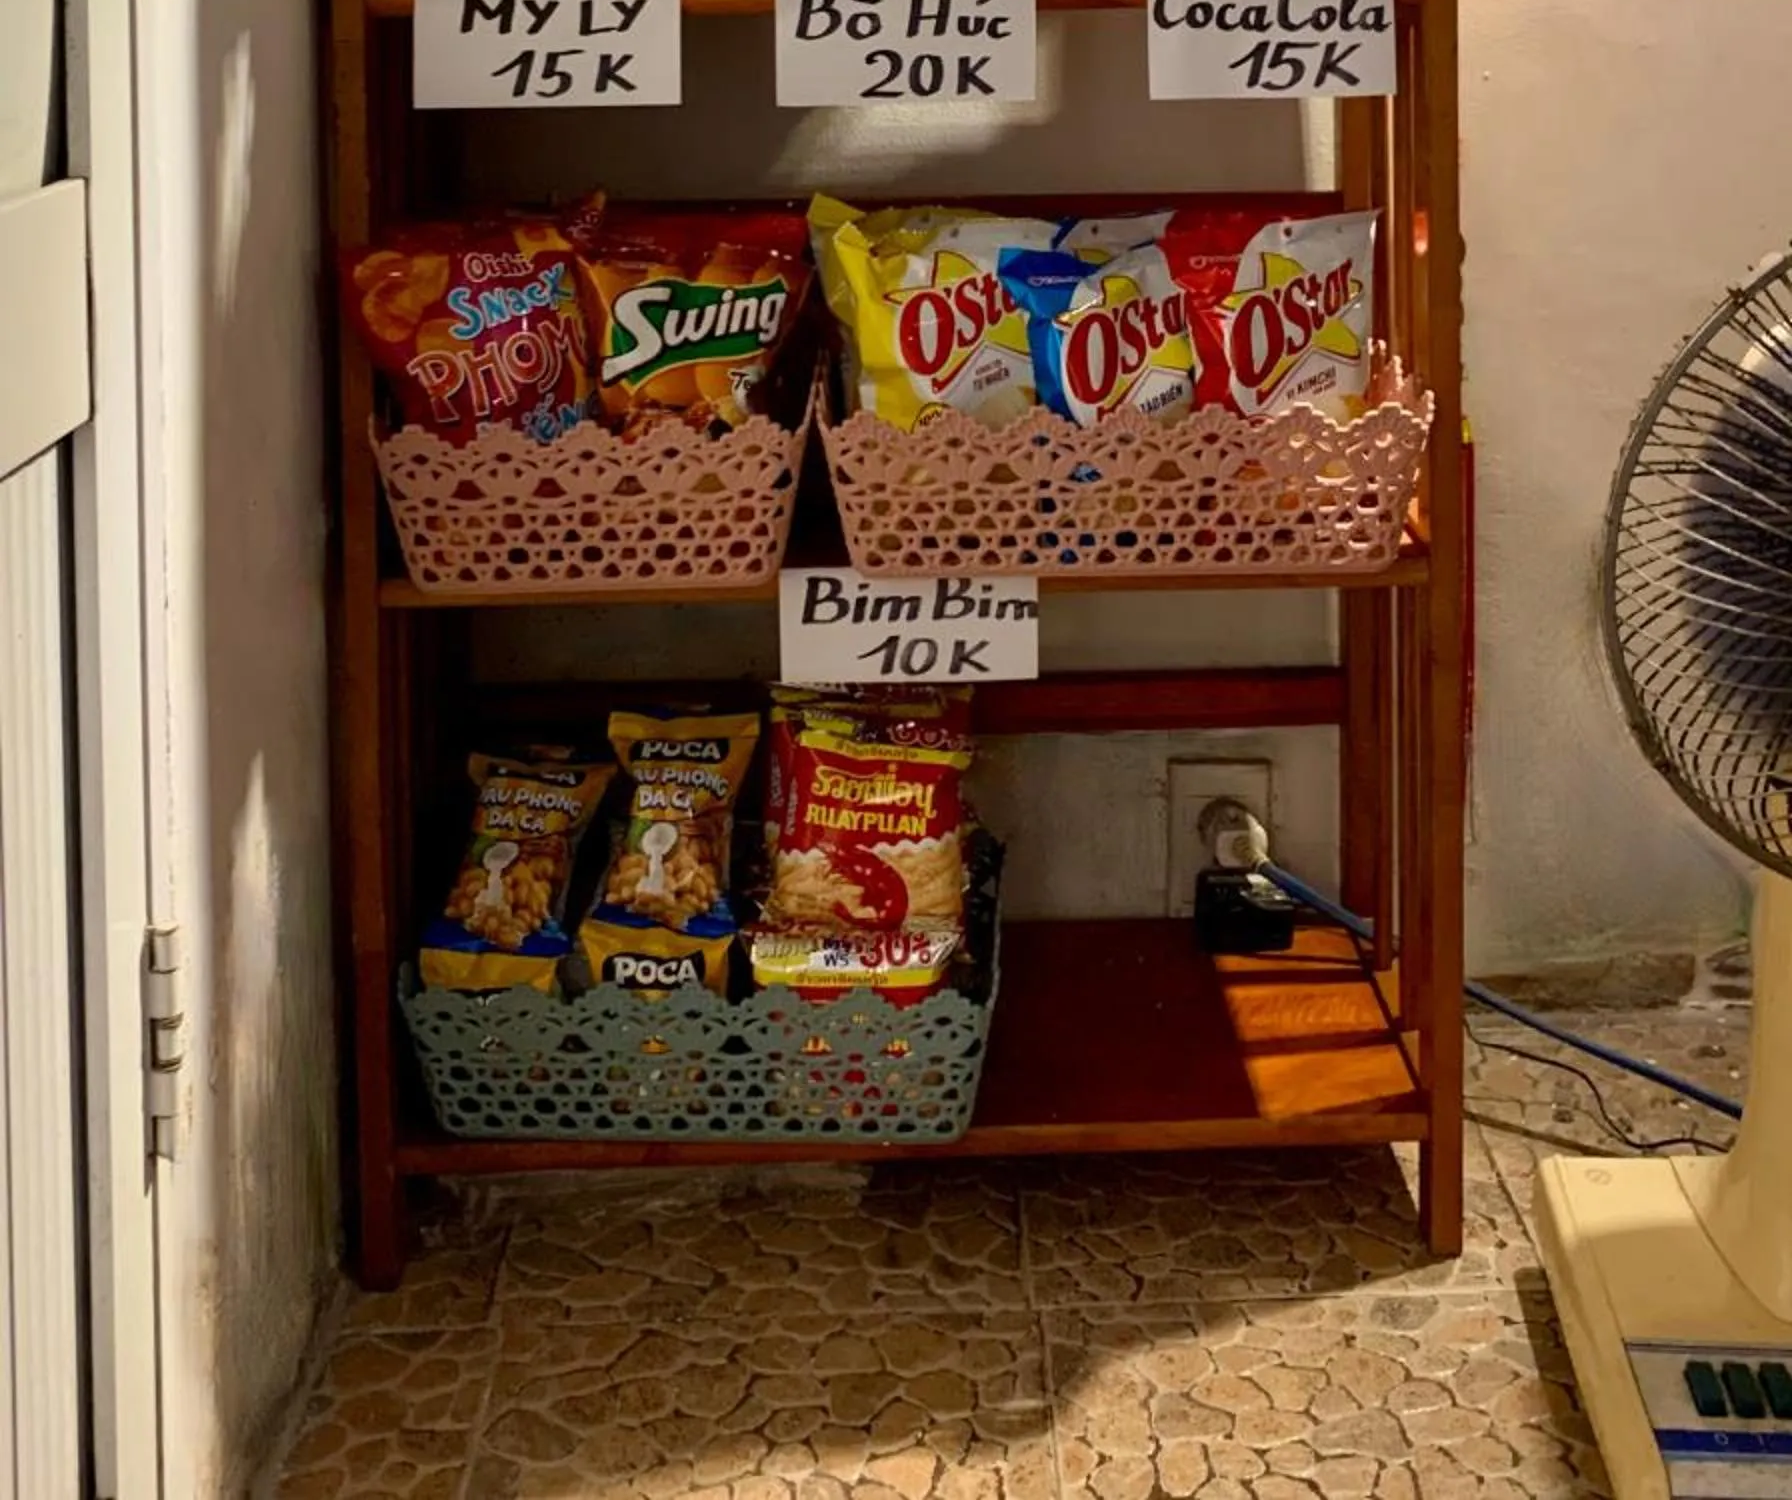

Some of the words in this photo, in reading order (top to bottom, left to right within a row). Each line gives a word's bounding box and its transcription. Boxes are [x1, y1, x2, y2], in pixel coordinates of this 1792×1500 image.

[1228, 40, 1361, 91] 15K
[463, 252, 535, 283] Oishi
[601, 286, 789, 384] Swing
[1231, 257, 1353, 389] O'Star
[1066, 293, 1184, 405] O'Sta
[801, 577, 922, 624] Bim
[932, 578, 1039, 621] Bim
[642, 740, 721, 760] POCA
[804, 803, 927, 836] RUAYPUAN
[860, 931, 931, 967] 30%
[614, 956, 699, 984] POCA
